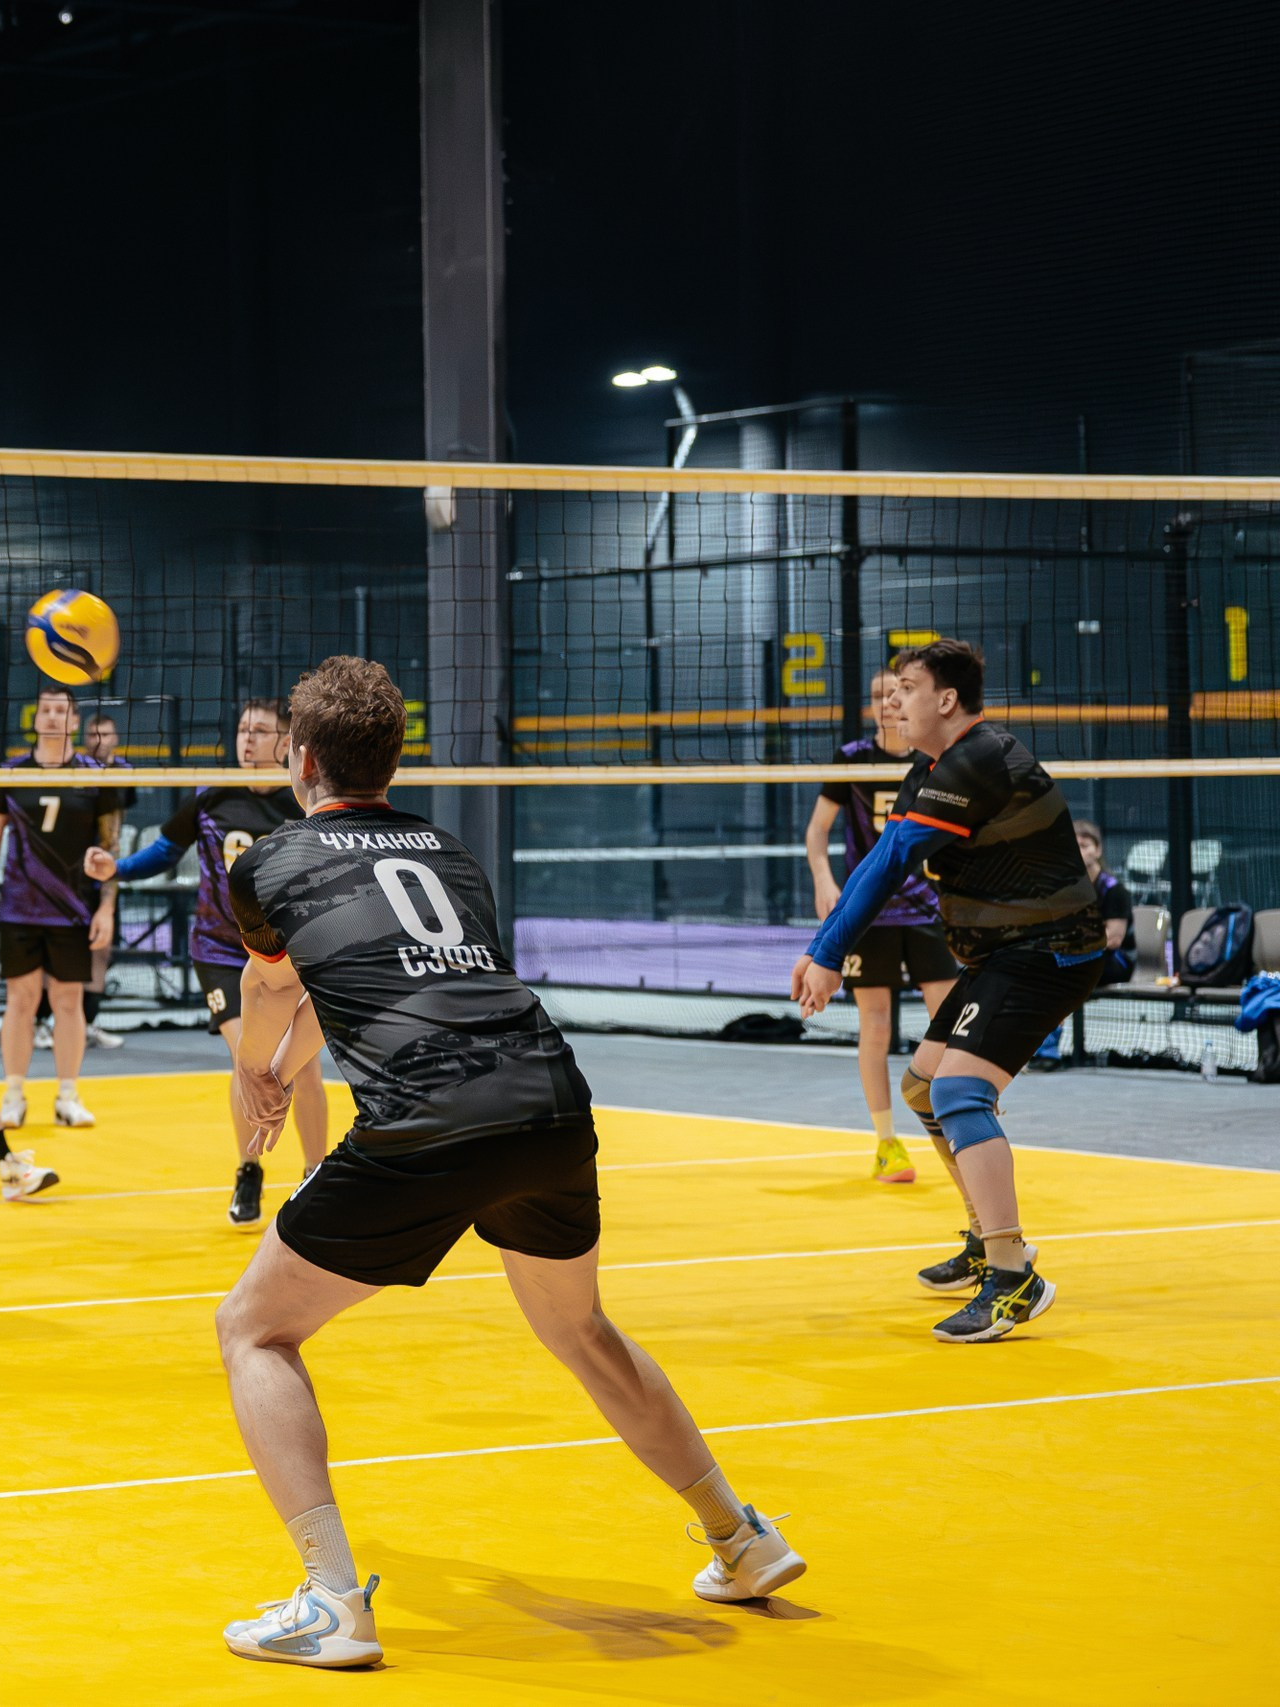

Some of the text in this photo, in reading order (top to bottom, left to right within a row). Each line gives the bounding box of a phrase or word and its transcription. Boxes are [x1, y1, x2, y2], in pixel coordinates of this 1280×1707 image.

[782, 633, 826, 696] 2
[38, 796, 61, 832] 7
[320, 831, 442, 851] ЧУХАНОВ
[373, 857, 464, 947] 0
[951, 1002, 980, 1038] 12
